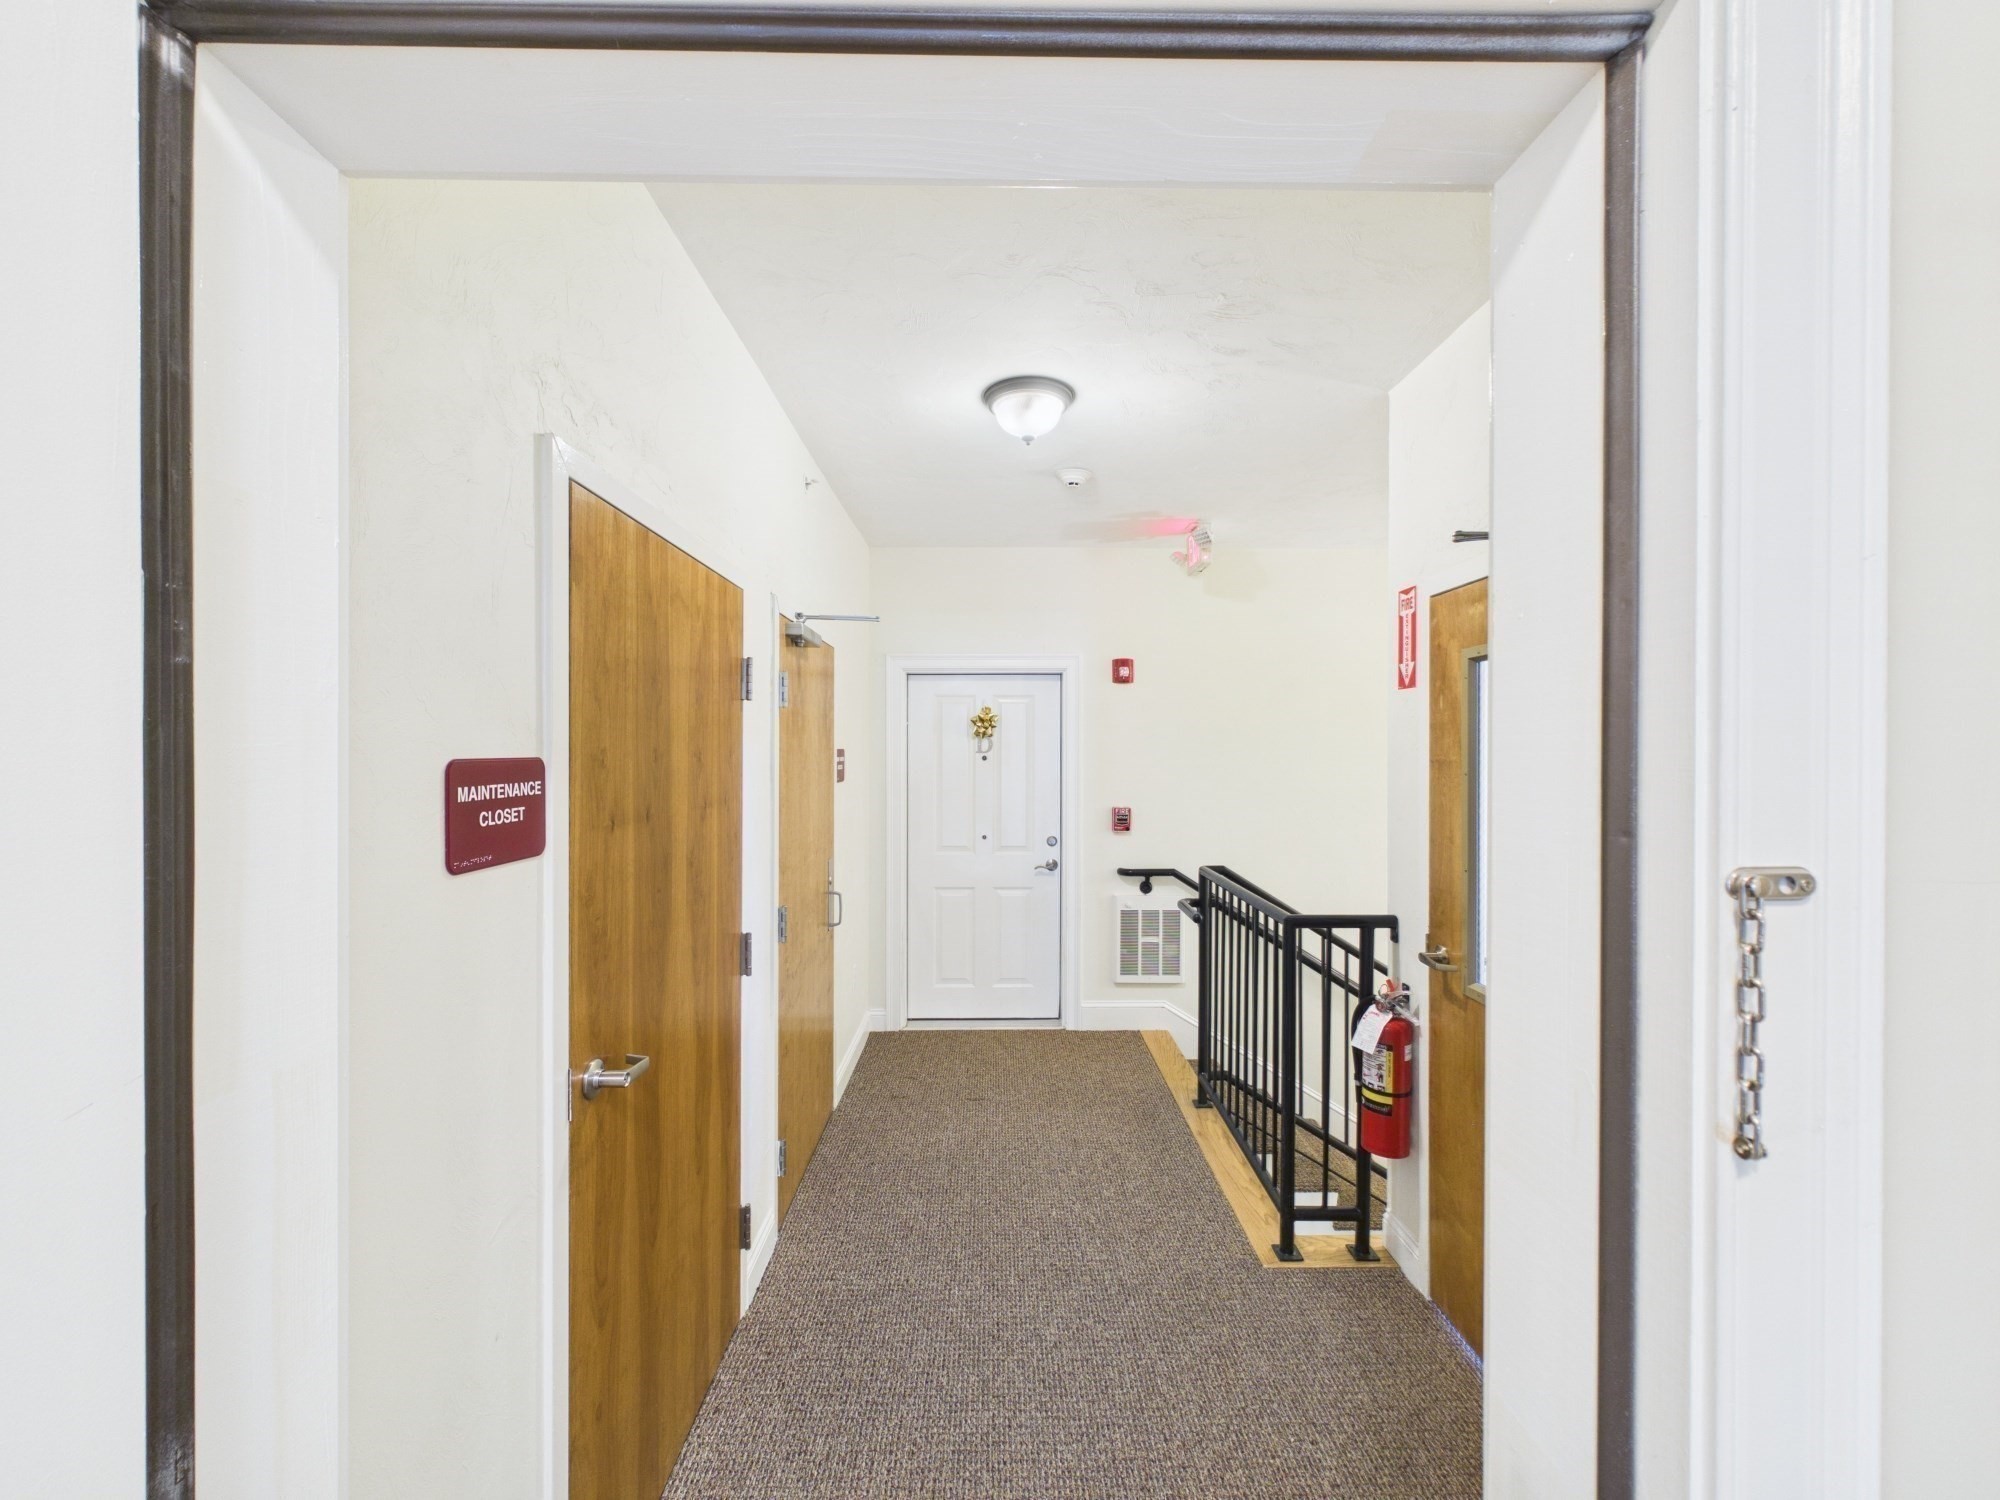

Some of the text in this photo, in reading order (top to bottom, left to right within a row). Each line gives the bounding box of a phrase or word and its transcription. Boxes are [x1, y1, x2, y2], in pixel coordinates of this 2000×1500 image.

[1401, 596, 1413, 612] FIRE
[457, 781, 542, 803] MAINTENANCE
[479, 806, 525, 827] CLOSET
